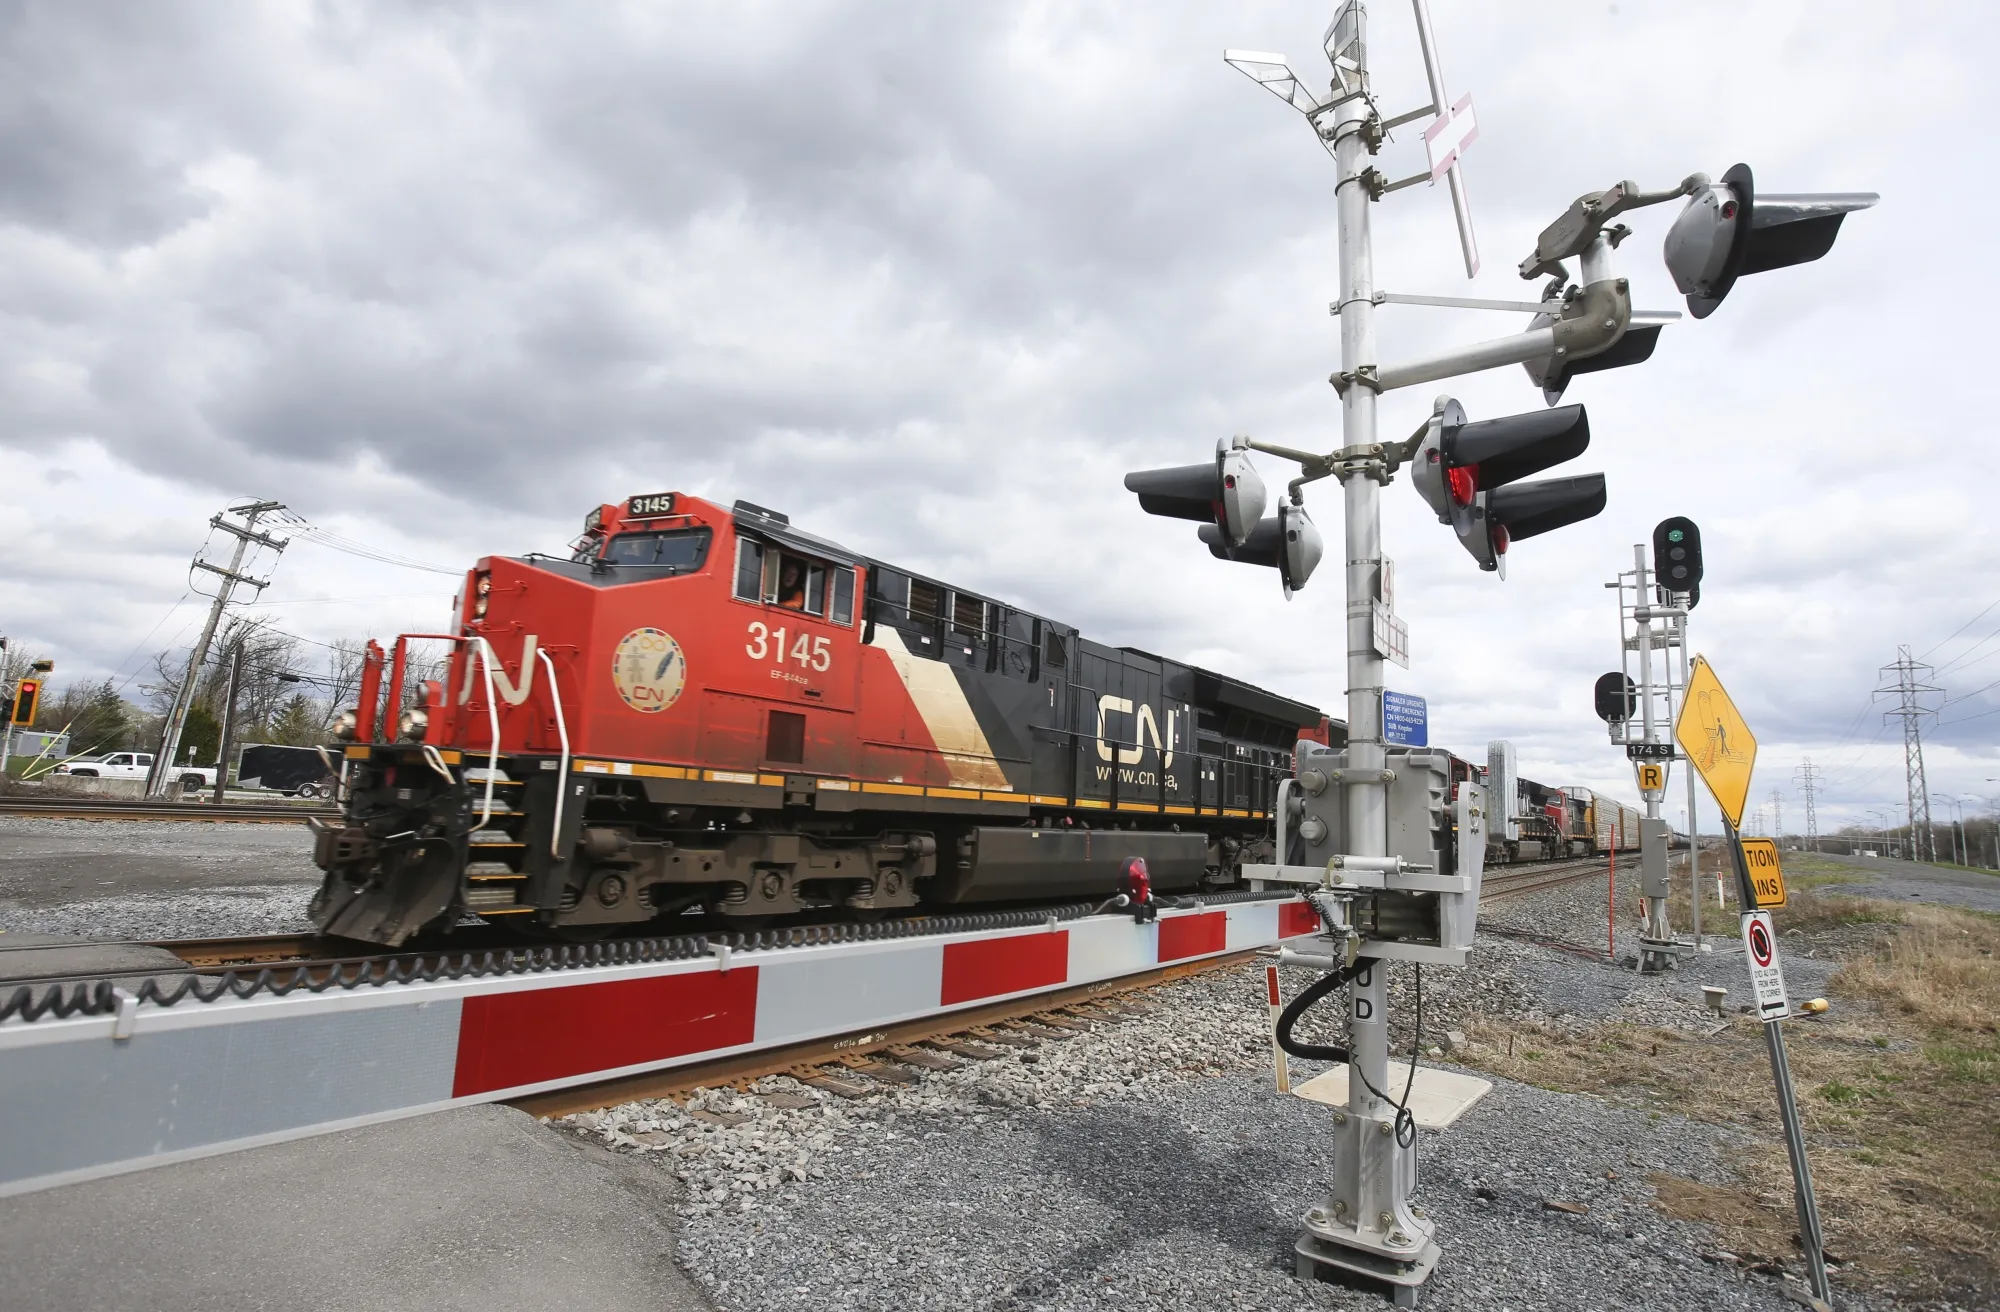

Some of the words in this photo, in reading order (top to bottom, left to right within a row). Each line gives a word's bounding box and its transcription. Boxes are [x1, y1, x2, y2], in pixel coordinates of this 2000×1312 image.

[632, 496, 671, 514] 3145
[745, 621, 831, 672] 3145
[633, 685, 665, 702] CN
[1385, 704, 1401, 712] REPORT
[1402, 707, 1425, 717] EMERGENCY
[1387, 713, 1394, 721] CN
[1096, 694, 1175, 769] CN
[1630, 745, 1653, 754] 174
[1659, 745, 1668, 754] S
[1096, 766, 1175, 788] ww.cn.a
[1644, 768, 1657, 786] R
[575, 785, 585, 796] F
[1746, 849, 1775, 867] TION
[1755, 878, 1779, 896] INS
